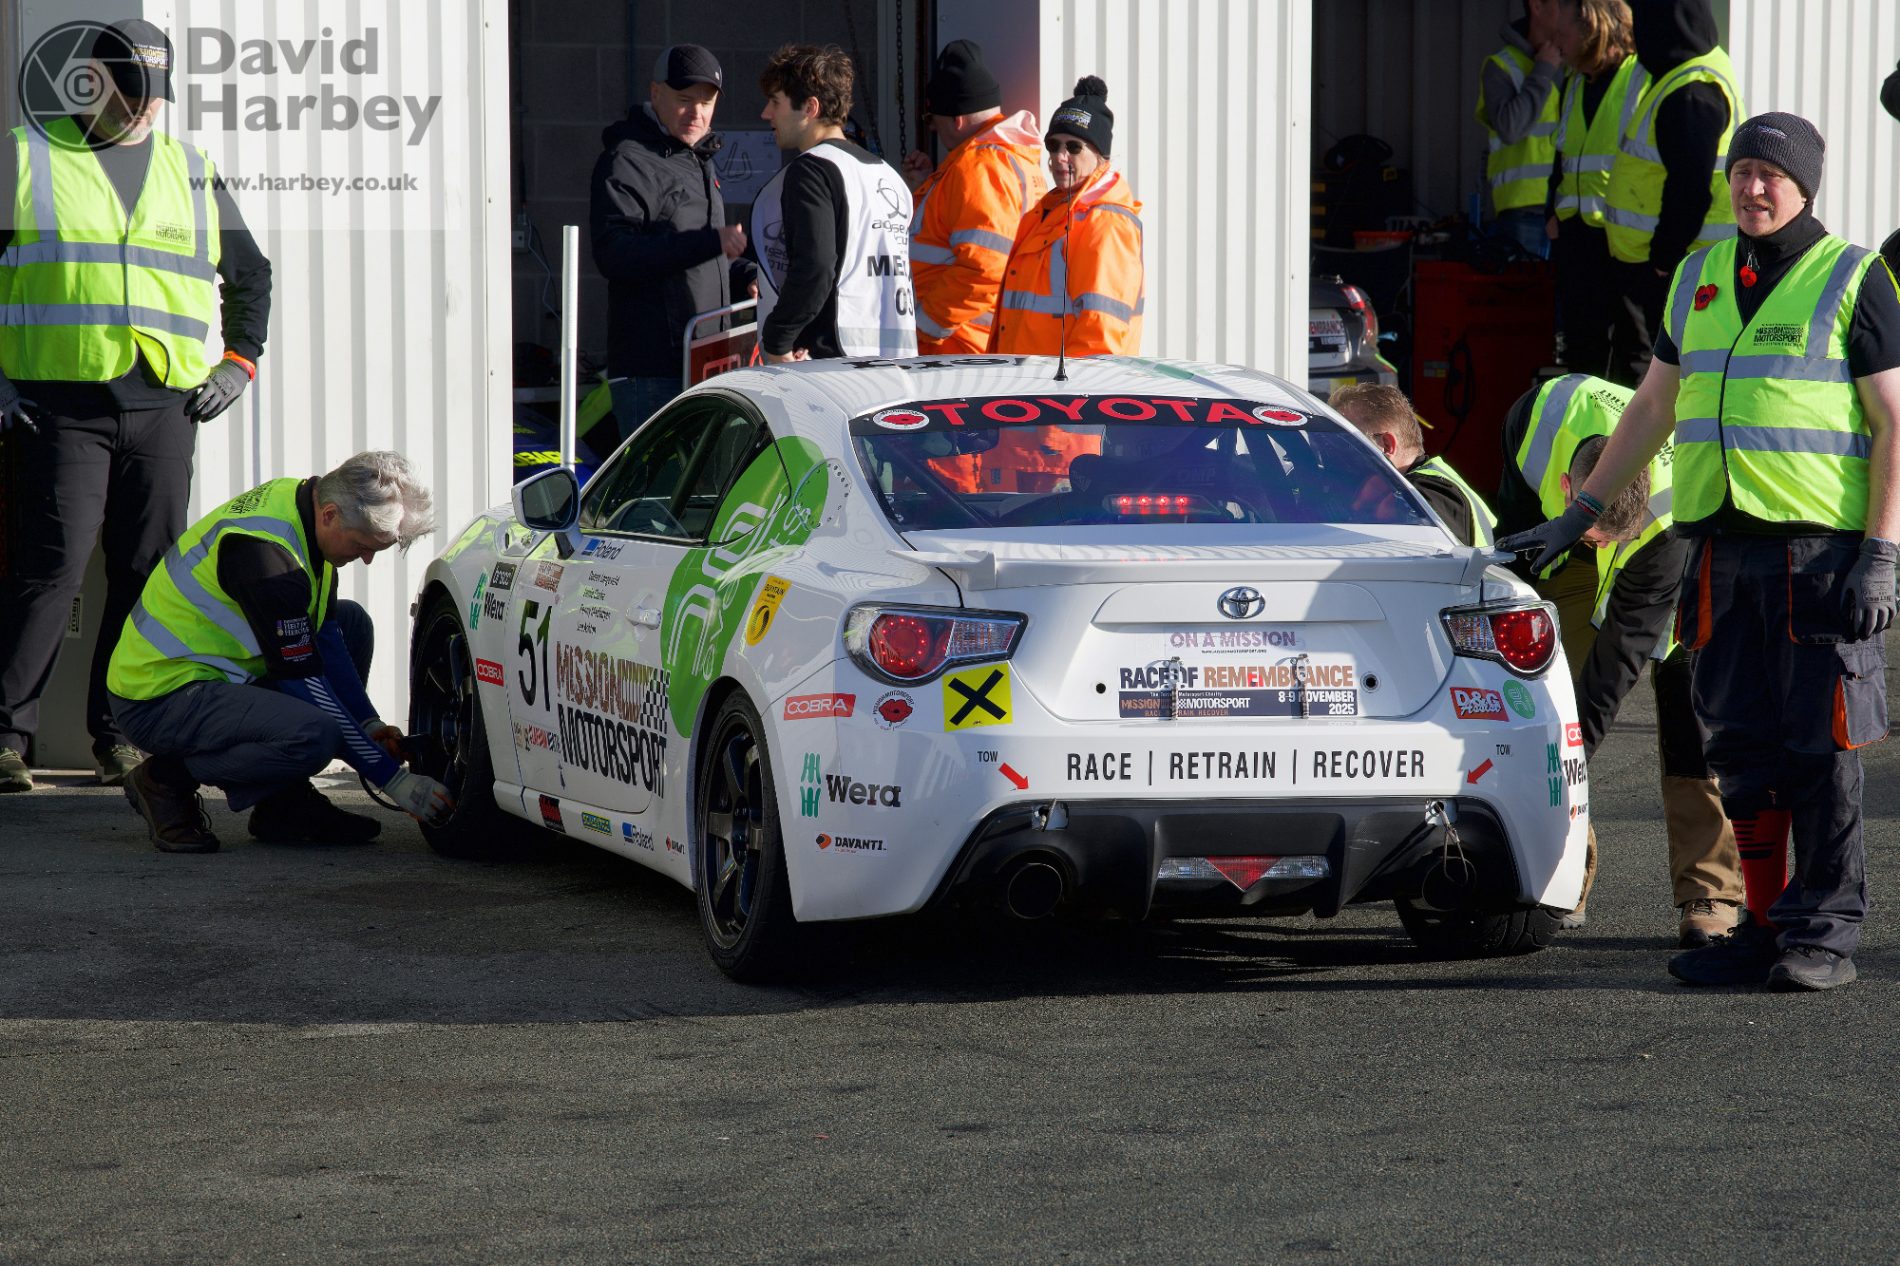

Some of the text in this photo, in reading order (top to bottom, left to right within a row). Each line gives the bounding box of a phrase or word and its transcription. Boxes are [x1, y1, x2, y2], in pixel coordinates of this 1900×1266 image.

[1753, 334, 1801, 343] MOTORSPORT
[923, 398, 1263, 425] TOYOTA
[484, 591, 506, 621] Wera
[1170, 631, 1297, 648] ON A MISSION
[518, 599, 552, 712] 51
[477, 664, 504, 681] COBRA
[556, 641, 622, 717] MISSION
[1121, 698, 1160, 710] MISSION
[1186, 698, 1251, 709] MOTORSPORT
[1278, 691, 1296, 703] 8-9
[1454, 690, 1500, 708] D&G
[786, 698, 848, 714] COBRA
[1328, 703, 1355, 715] 2025
[557, 703, 667, 799] MOTORSPORT
[977, 750, 998, 763] TOW
[1496, 744, 1511, 755] TOW
[1067, 752, 1132, 780] RACE
[1169, 751, 1276, 779] RETRAIN
[1313, 750, 1425, 778] RECOVER
[826, 774, 902, 808] Wera
